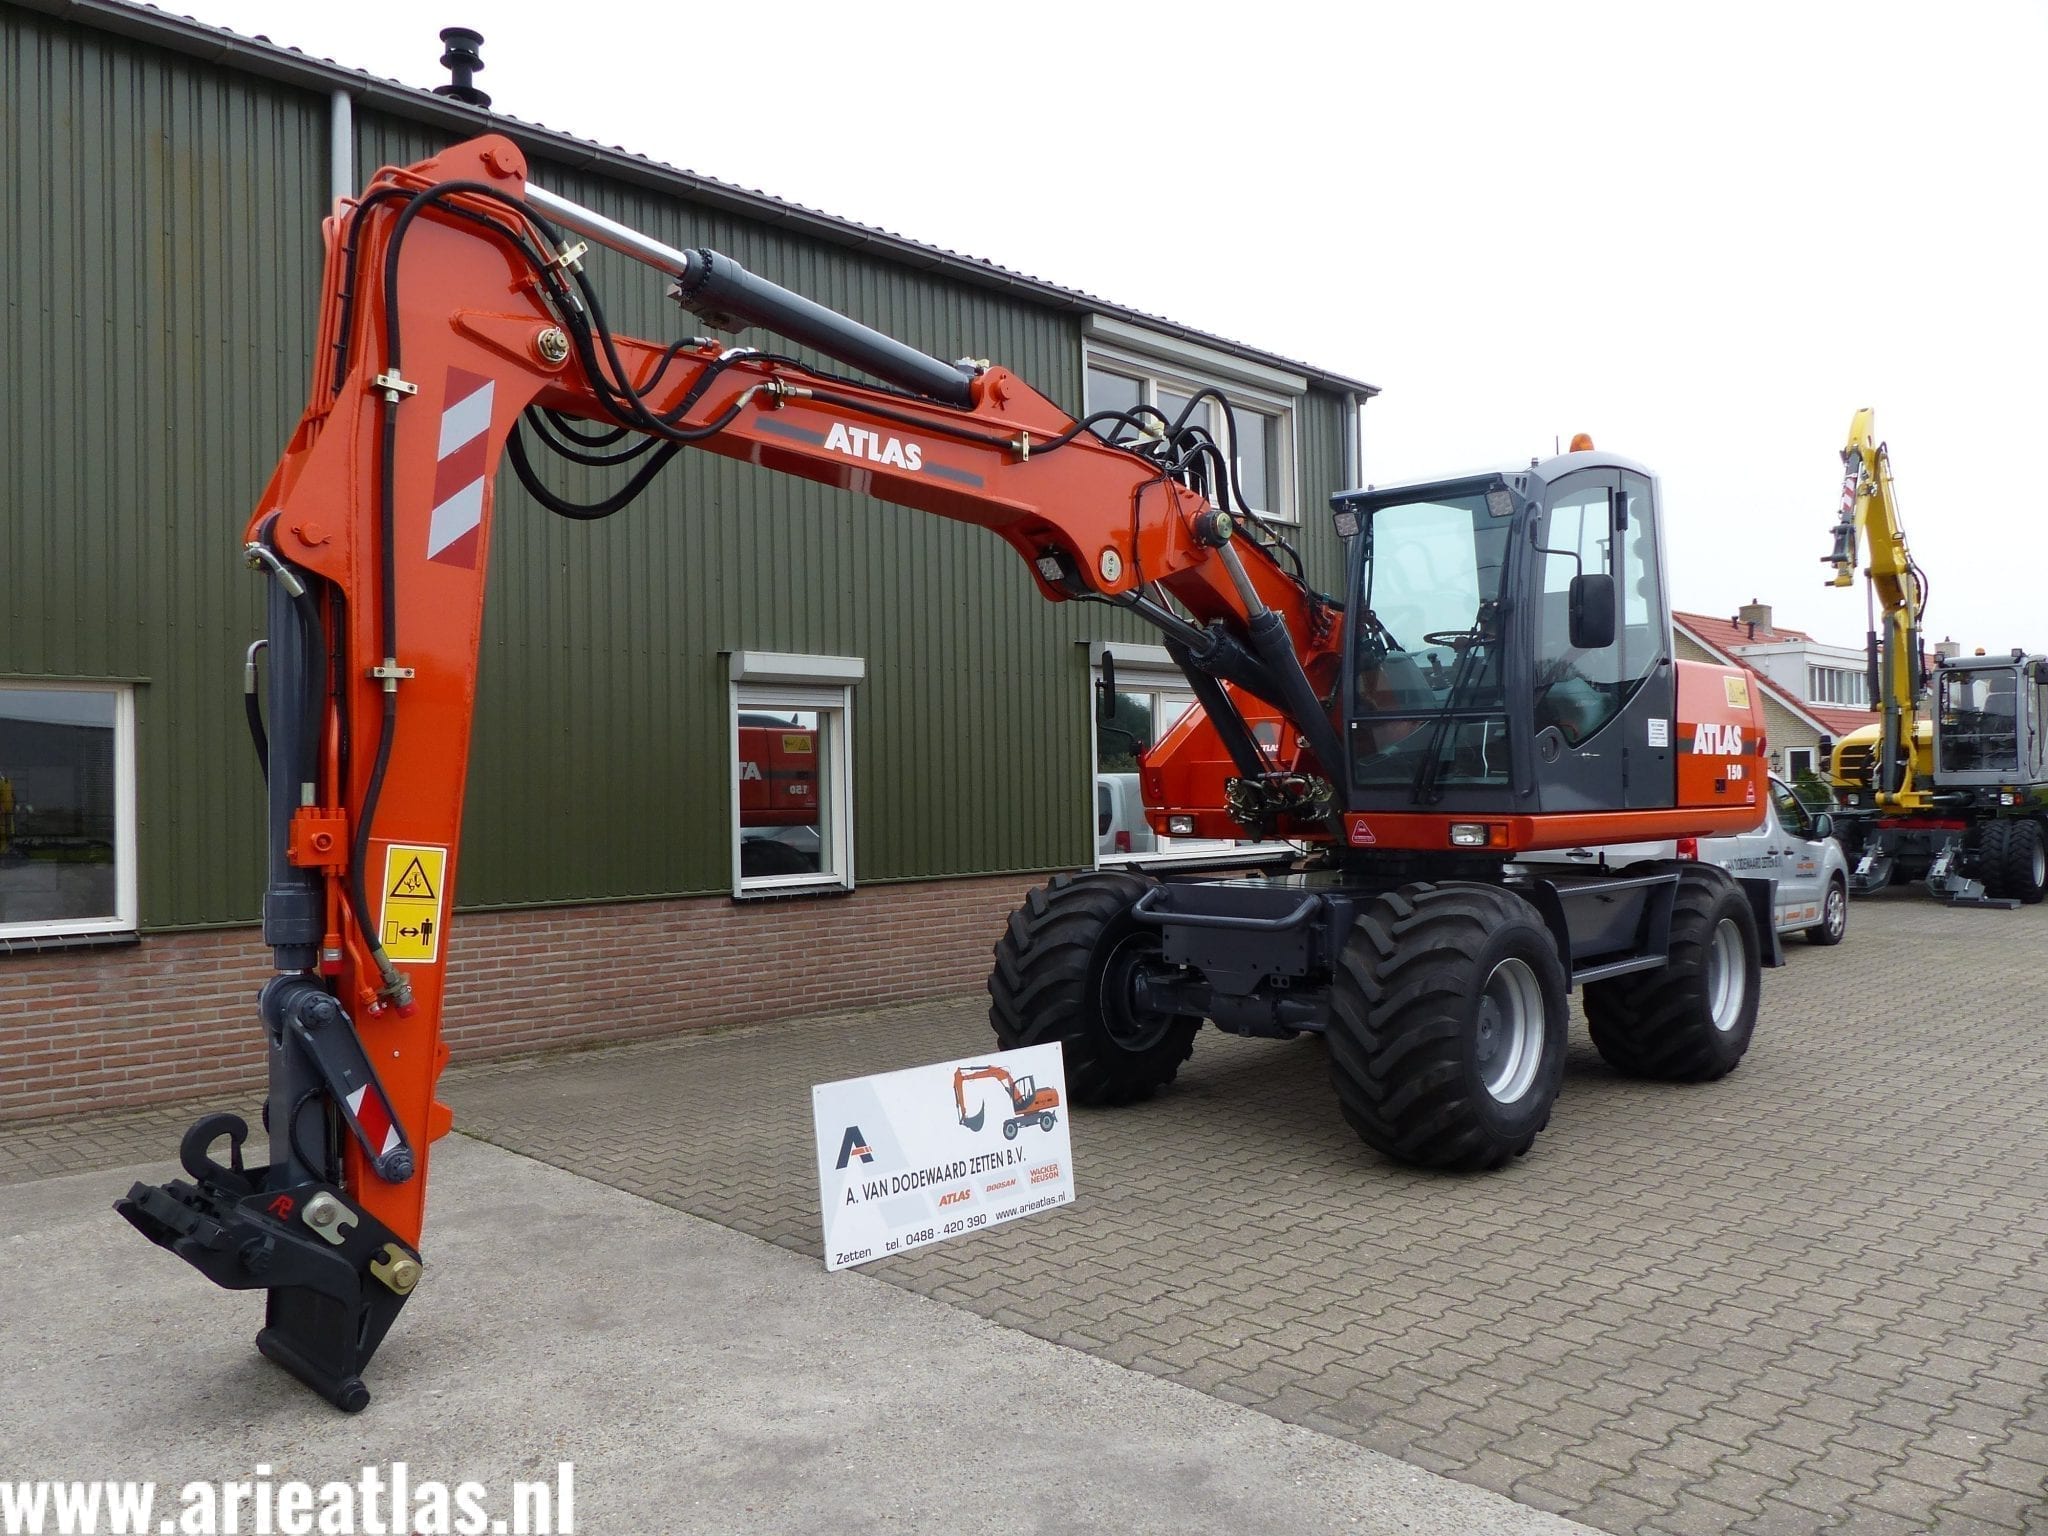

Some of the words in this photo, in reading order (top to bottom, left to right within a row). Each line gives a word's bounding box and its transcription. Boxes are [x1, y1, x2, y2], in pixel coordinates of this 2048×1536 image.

[824, 422, 922, 471] ATLAS
[1692, 723, 1742, 756] ATLAS
[1726, 764, 1742, 780] 150
[846, 1187, 859, 1206] A.
[862, 1178, 889, 1201] VAN
[892, 1160, 967, 1194] DODEWAARD
[969, 1150, 1004, 1175] ZETTEN
[1006, 1146, 1027, 1166] B.V.
[1029, 1163, 1059, 1177] WACKER
[1030, 1171, 1059, 1185] NEUSON
[986, 1178, 1016, 1193] DOOSAN
[939, 1188, 971, 1207] ATLAS
[836, 1248, 872, 1265] Zetten
[885, 1237, 902, 1251] tel.
[905, 1228, 935, 1246] 0488
[943, 1219, 964, 1235] 420
[967, 1213, 987, 1229] 390
[995, 1190, 1066, 1221] www.arieatlas.nl
